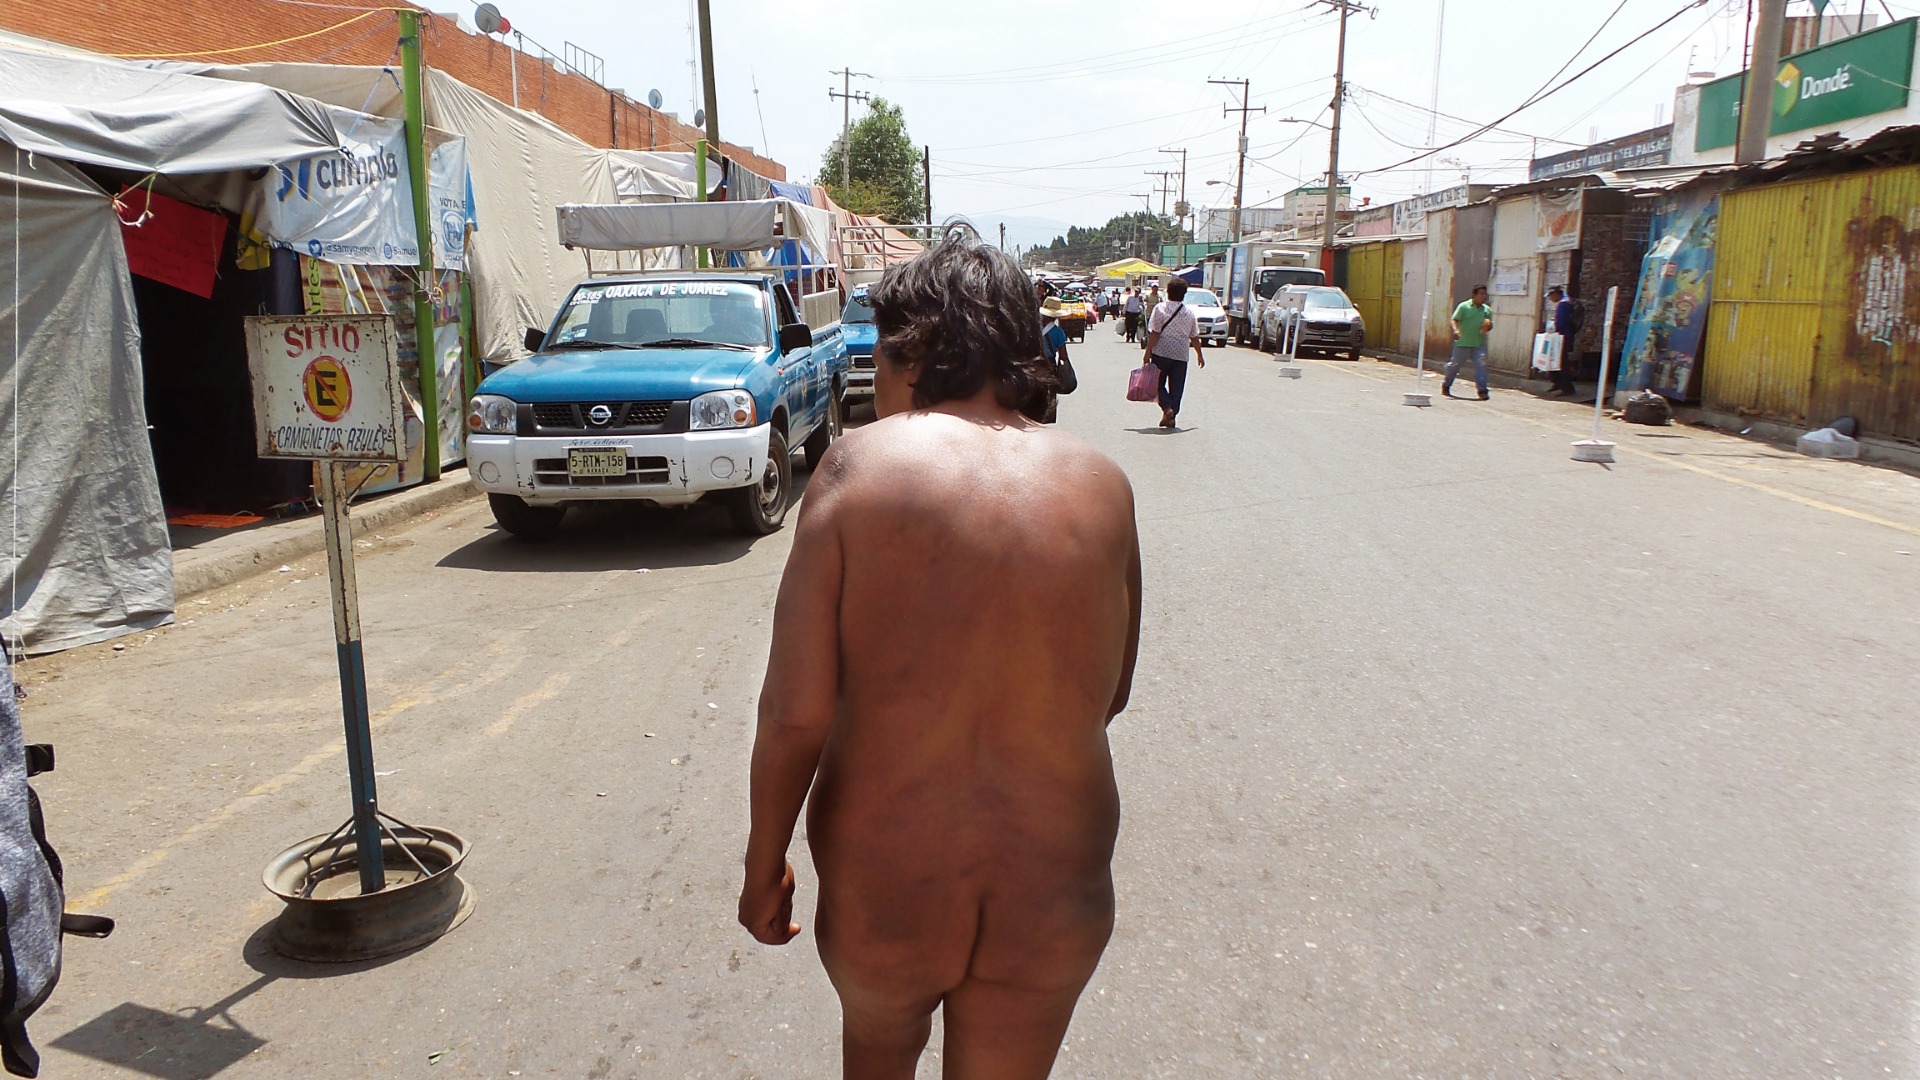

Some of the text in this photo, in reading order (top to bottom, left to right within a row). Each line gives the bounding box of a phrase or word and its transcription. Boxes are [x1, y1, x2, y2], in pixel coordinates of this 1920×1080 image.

[1801, 64, 1851, 100] Dondé
[605, 284, 653, 298] OAXACA
[660, 283, 676, 296] DE
[284, 323, 360, 358] SITIO
[315, 371, 337, 406] E
[277, 425, 387, 452] CAMIONETAS AZULES
[572, 454, 623, 468] 5-RTM-158
